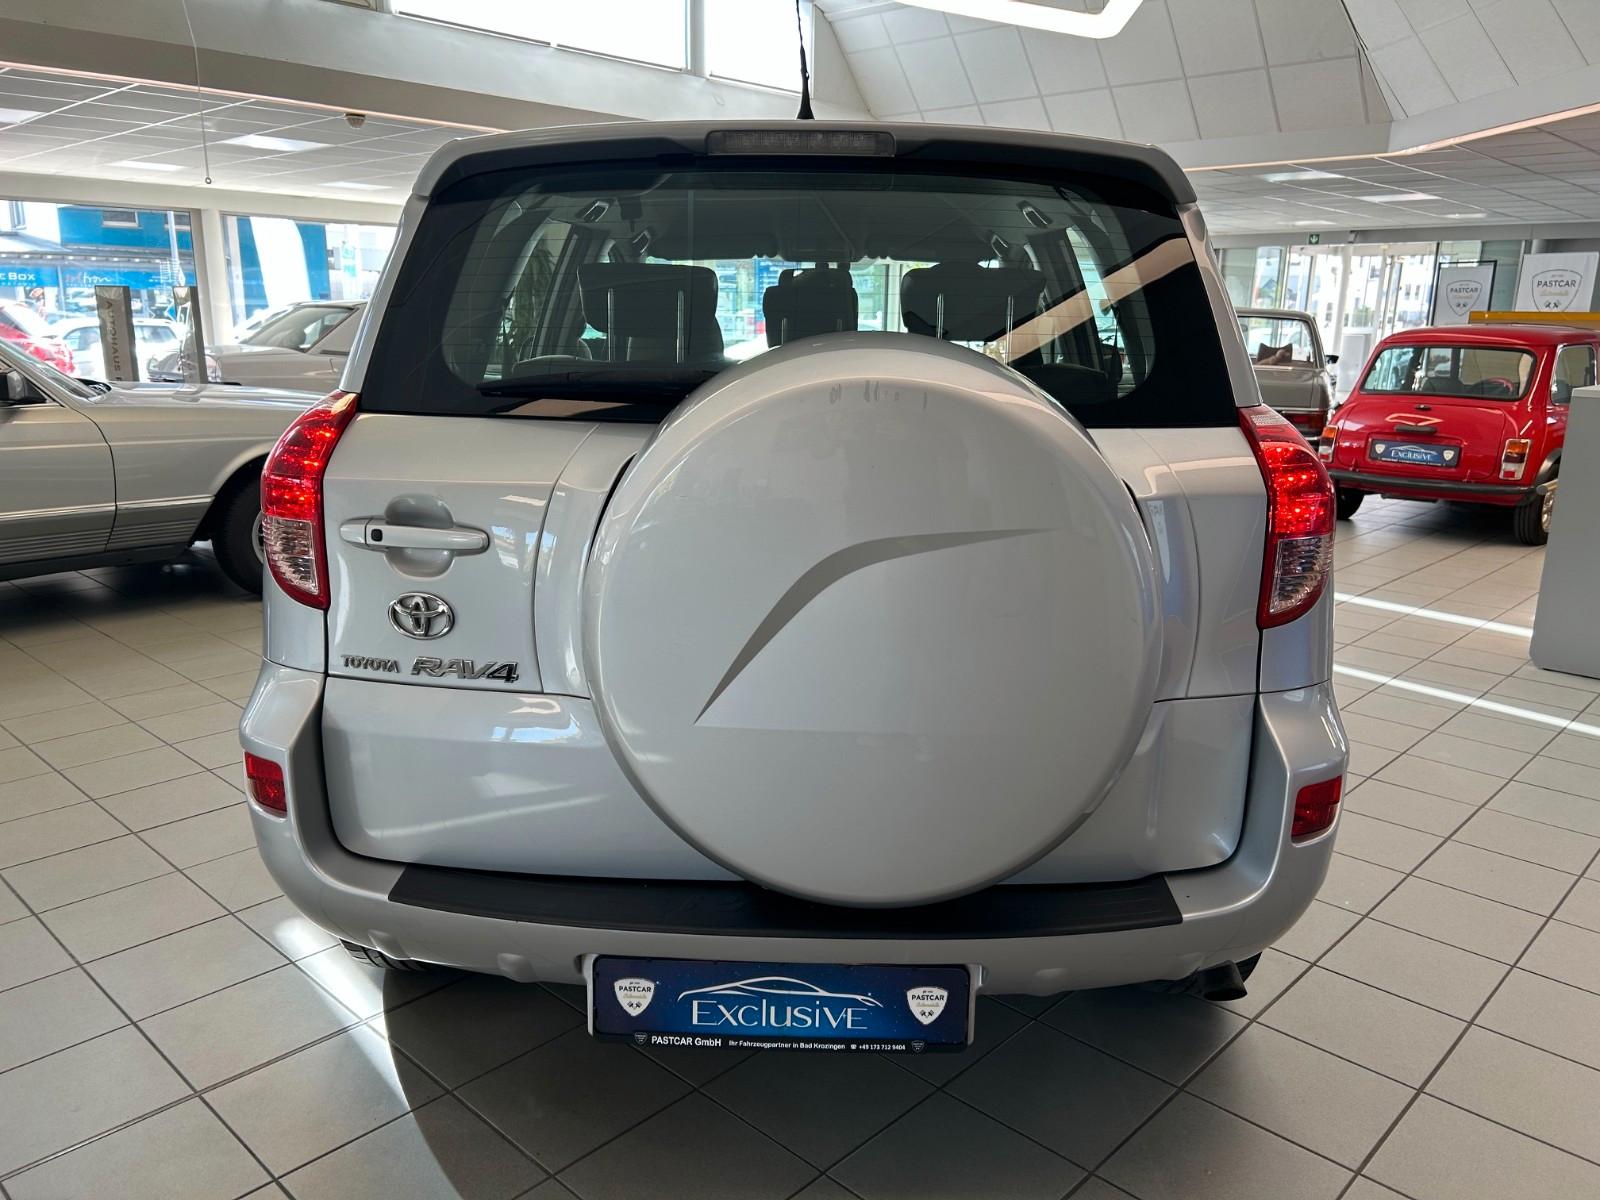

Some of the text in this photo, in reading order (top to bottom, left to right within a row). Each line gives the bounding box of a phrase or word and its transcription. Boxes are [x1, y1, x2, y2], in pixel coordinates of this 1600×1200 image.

[8, 272, 36, 281] Box
[1537, 279, 1577, 288] PASTCAR
[103, 300, 121, 372] AUTOHAUS
[341, 654, 520, 683] TOYOTA RAV4
[618, 985, 652, 993] PASTCAR
[651, 1035, 693, 1046] PASTCAR
[694, 1037, 722, 1047] GmbH
[739, 1040, 792, 1049] Fahrzeugpartner
[813, 1042, 846, 1050] Krozingen
